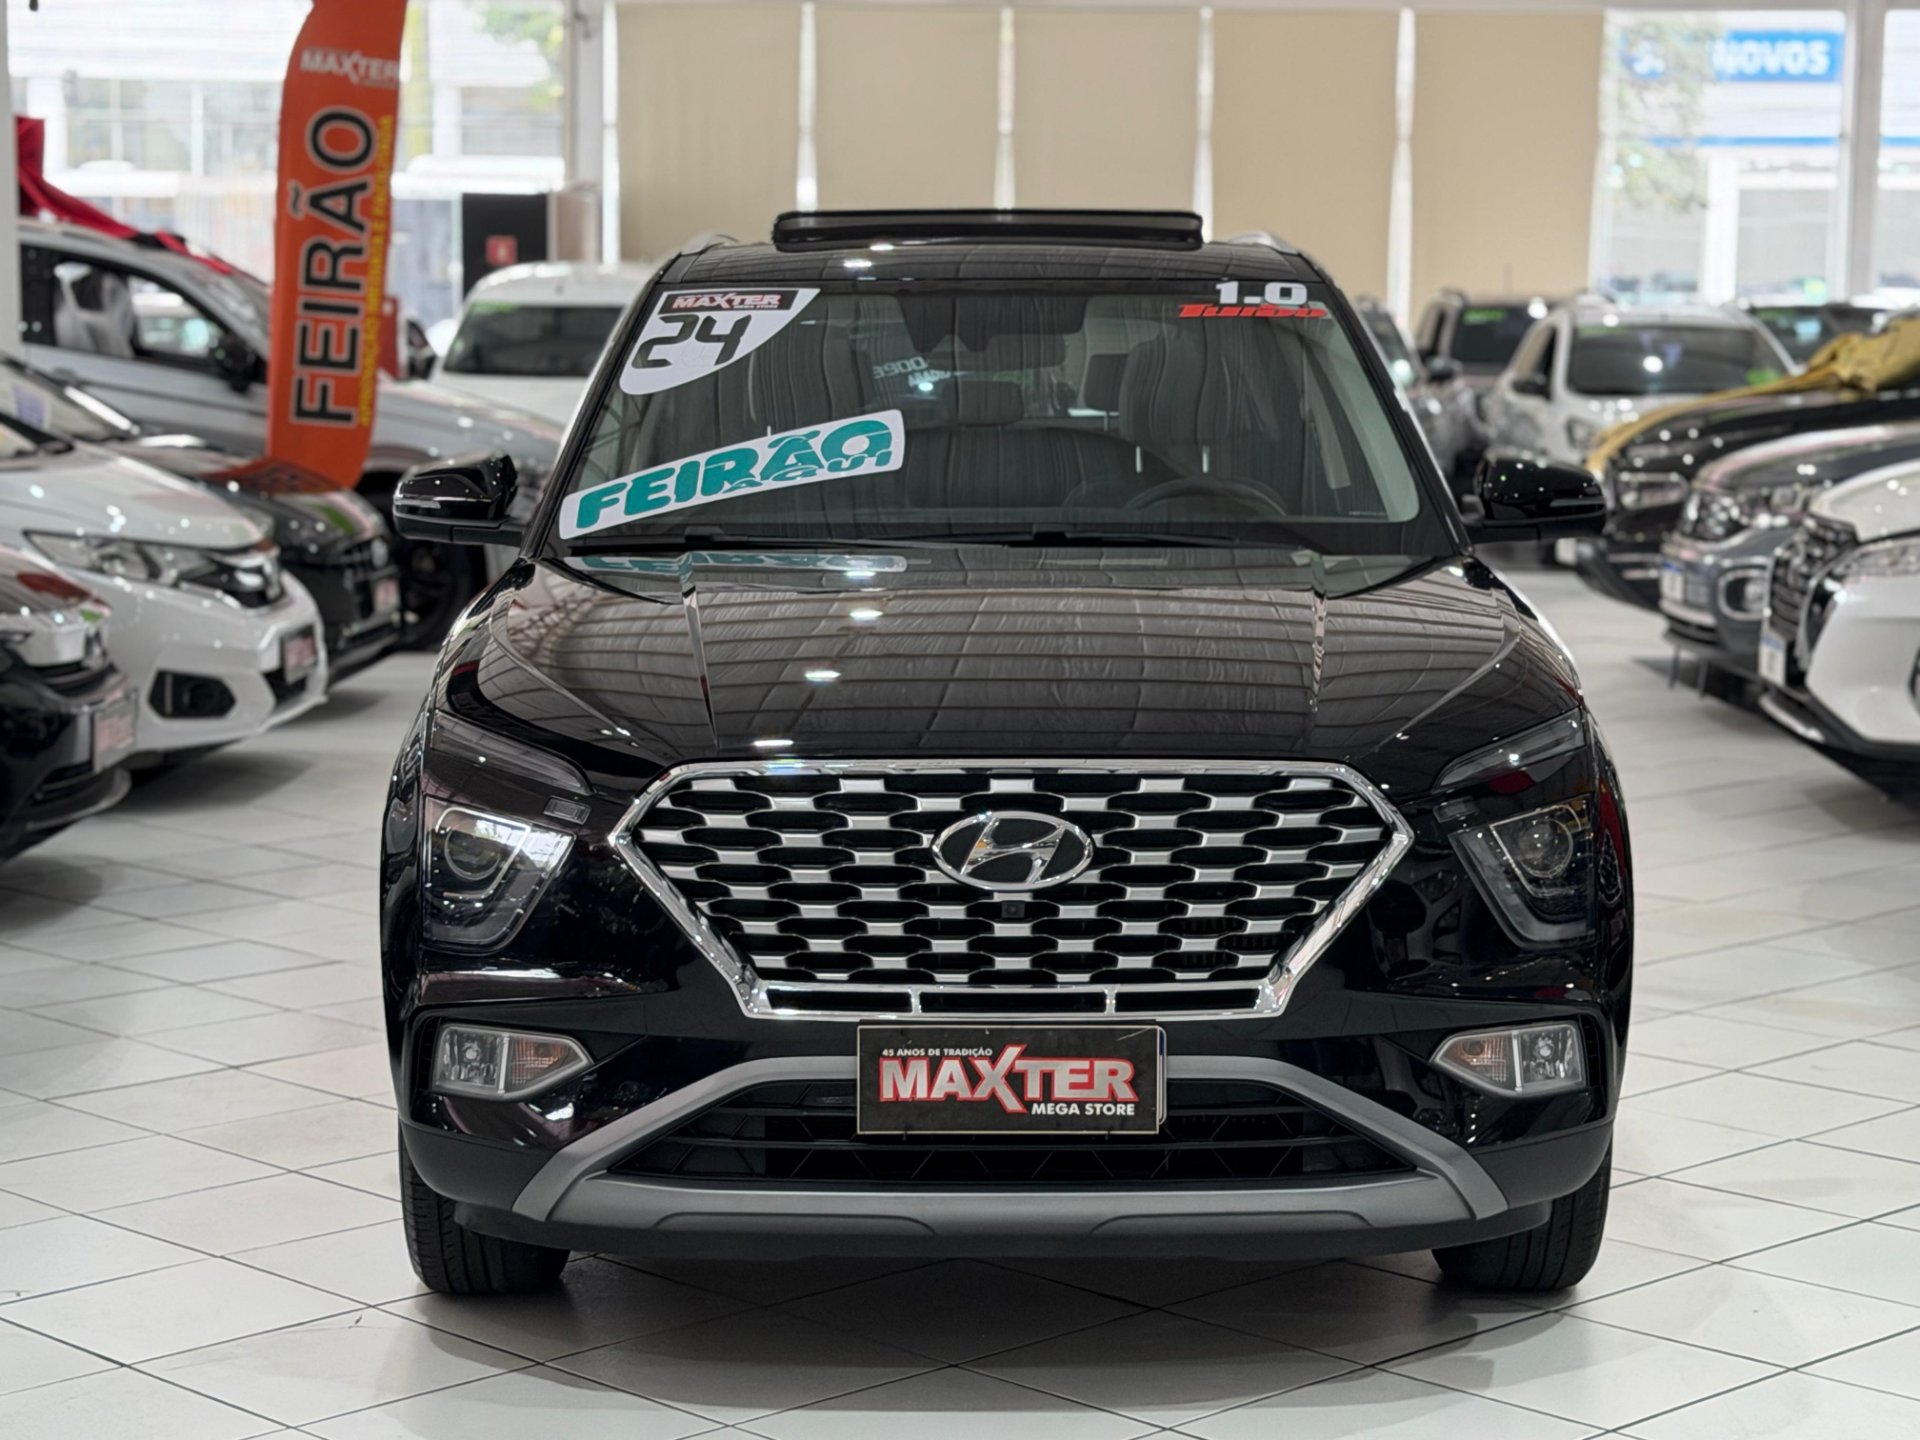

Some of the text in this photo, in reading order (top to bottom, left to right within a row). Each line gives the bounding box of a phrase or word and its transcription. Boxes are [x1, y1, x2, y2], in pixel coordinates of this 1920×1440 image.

[288, 105, 379, 427] FEIRÃO
[672, 291, 782, 310] MAXTER
[1216, 281, 1308, 305] 1.0
[630, 314, 753, 370] 24
[575, 419, 894, 529] FEIRÃO
[882, 1046, 993, 1058] 45 ANOS DE TRADIÇÃO
[879, 1044, 1140, 1113] MAXTER
[1031, 1102, 1136, 1116] MEGA STORE
